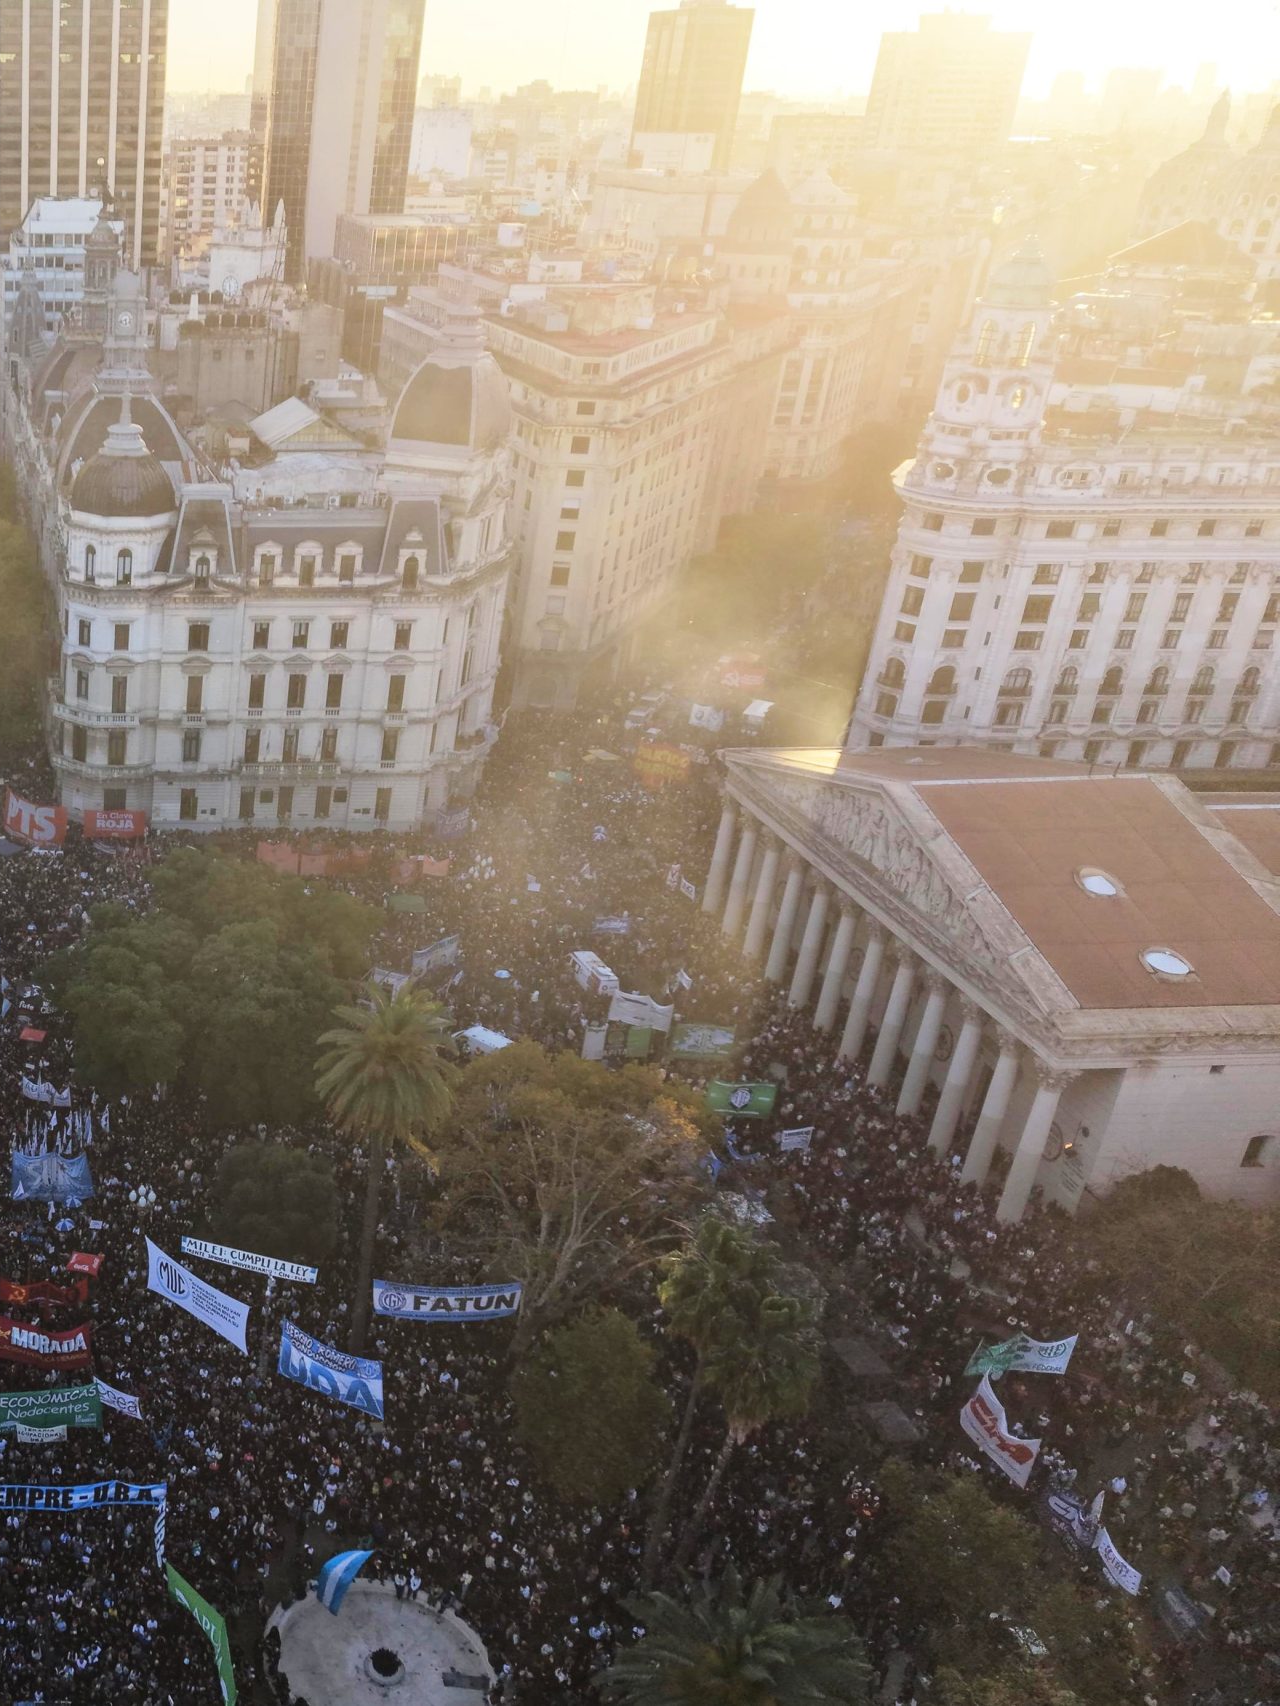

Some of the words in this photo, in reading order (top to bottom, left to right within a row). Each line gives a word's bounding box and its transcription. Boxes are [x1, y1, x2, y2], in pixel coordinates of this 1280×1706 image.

[8, 791, 56, 841] PTS
[96, 819, 135, 829] ROJA
[230, 1249, 271, 1269] CUMPLI
[274, 1261, 286, 1272] LA
[290, 1265, 309, 1277] LEY
[159, 1260, 186, 1295] MUC
[413, 1291, 518, 1312] FATUN
[10, 1326, 88, 1354] MORADA
[286, 1320, 313, 1349] SERGIO
[318, 1342, 358, 1371] ROMERO
[280, 1336, 383, 1418] UDA
[0, 1385, 97, 1408] ECONÓMICAS
[6, 1402, 90, 1420] Nodocentes
